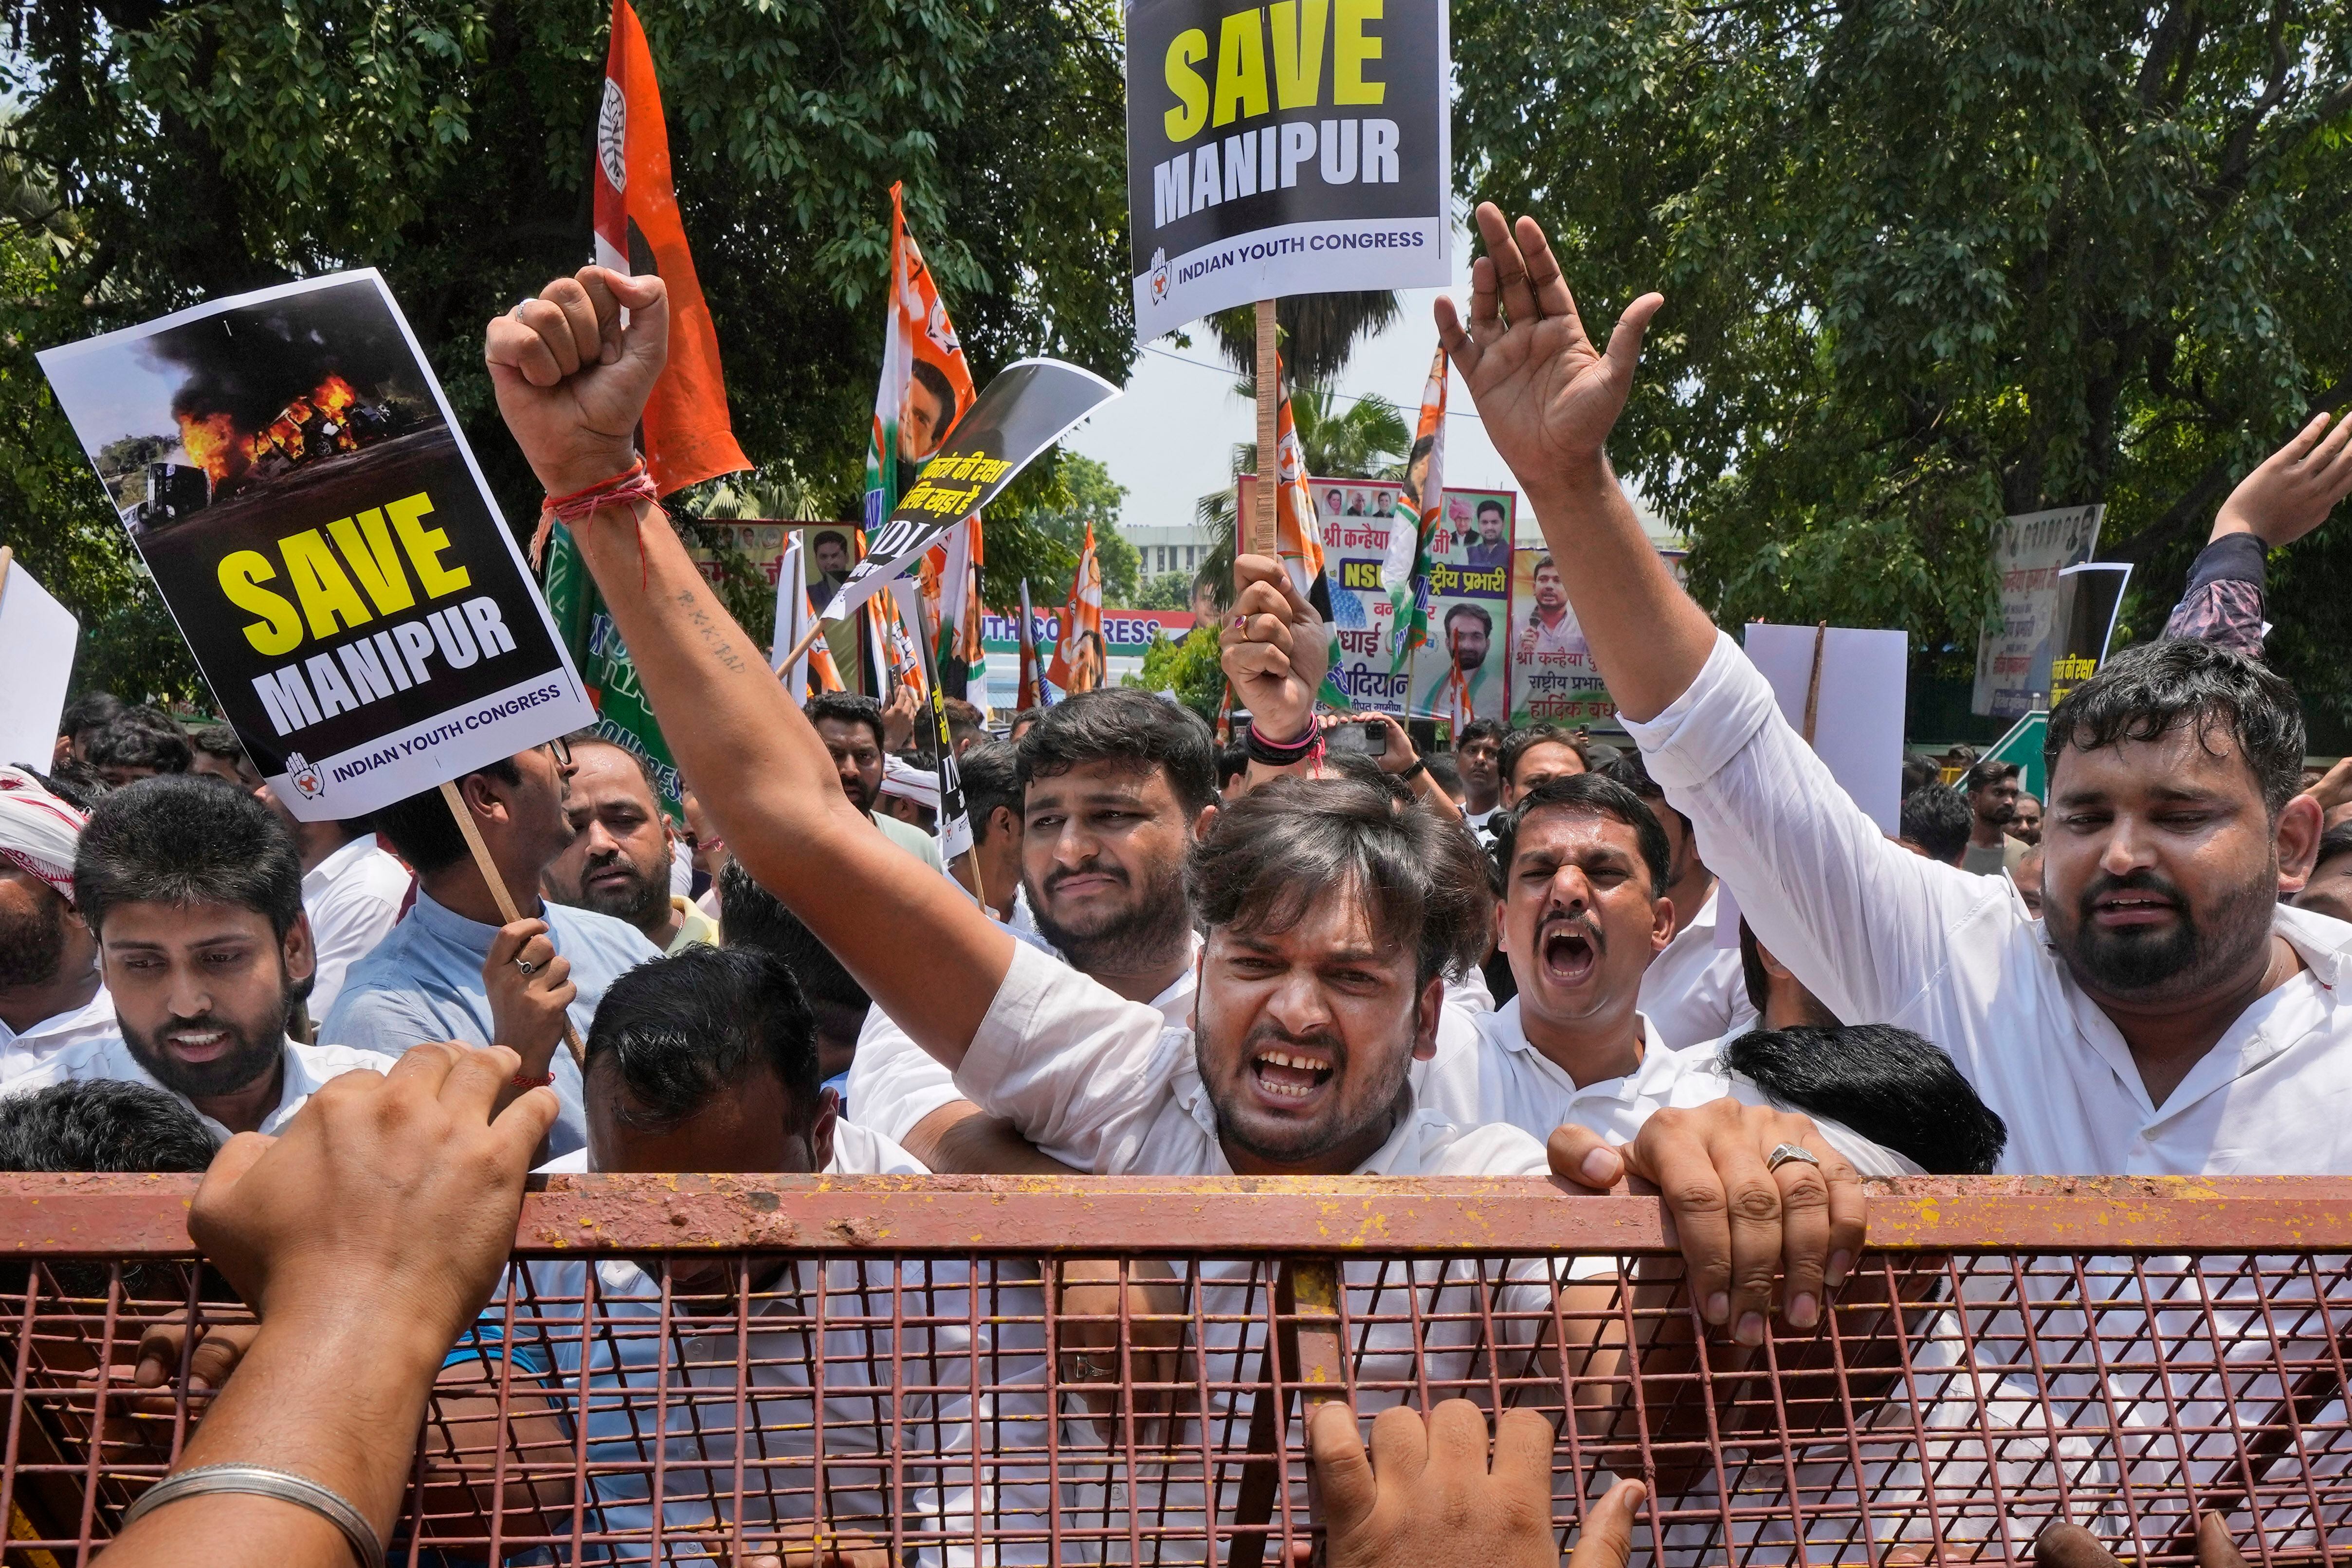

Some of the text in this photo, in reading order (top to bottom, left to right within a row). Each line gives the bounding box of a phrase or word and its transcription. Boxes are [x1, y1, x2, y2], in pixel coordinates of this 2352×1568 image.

[1164, 0, 1386, 143] SAVE
[1154, 119, 1400, 229] MANIPUR
[1179, 231, 1423, 284] INDIAN YOUTH CONGRESS
[951, 451, 985, 480] की
[970, 458, 1014, 483] रक्षा
[924, 488, 967, 518] खड़ा
[1324, 523, 1452, 554] श्री कन्हैया जी
[217, 492, 472, 656] SAVE
[1462, 566, 1506, 593] प्रभारी
[1337, 622, 1381, 657] धाई
[251, 596, 517, 737] MANIPUR
[1537, 646, 1584, 668] कन्हैया
[1528, 671, 1604, 693] राष्ट्रीय प्रभार
[1529, 693, 1584, 721] हार्दिक
[332, 747, 400, 783] INDIAN
[399, 721, 464, 756] YOUTH
[465, 684, 561, 729] CONGRESS
